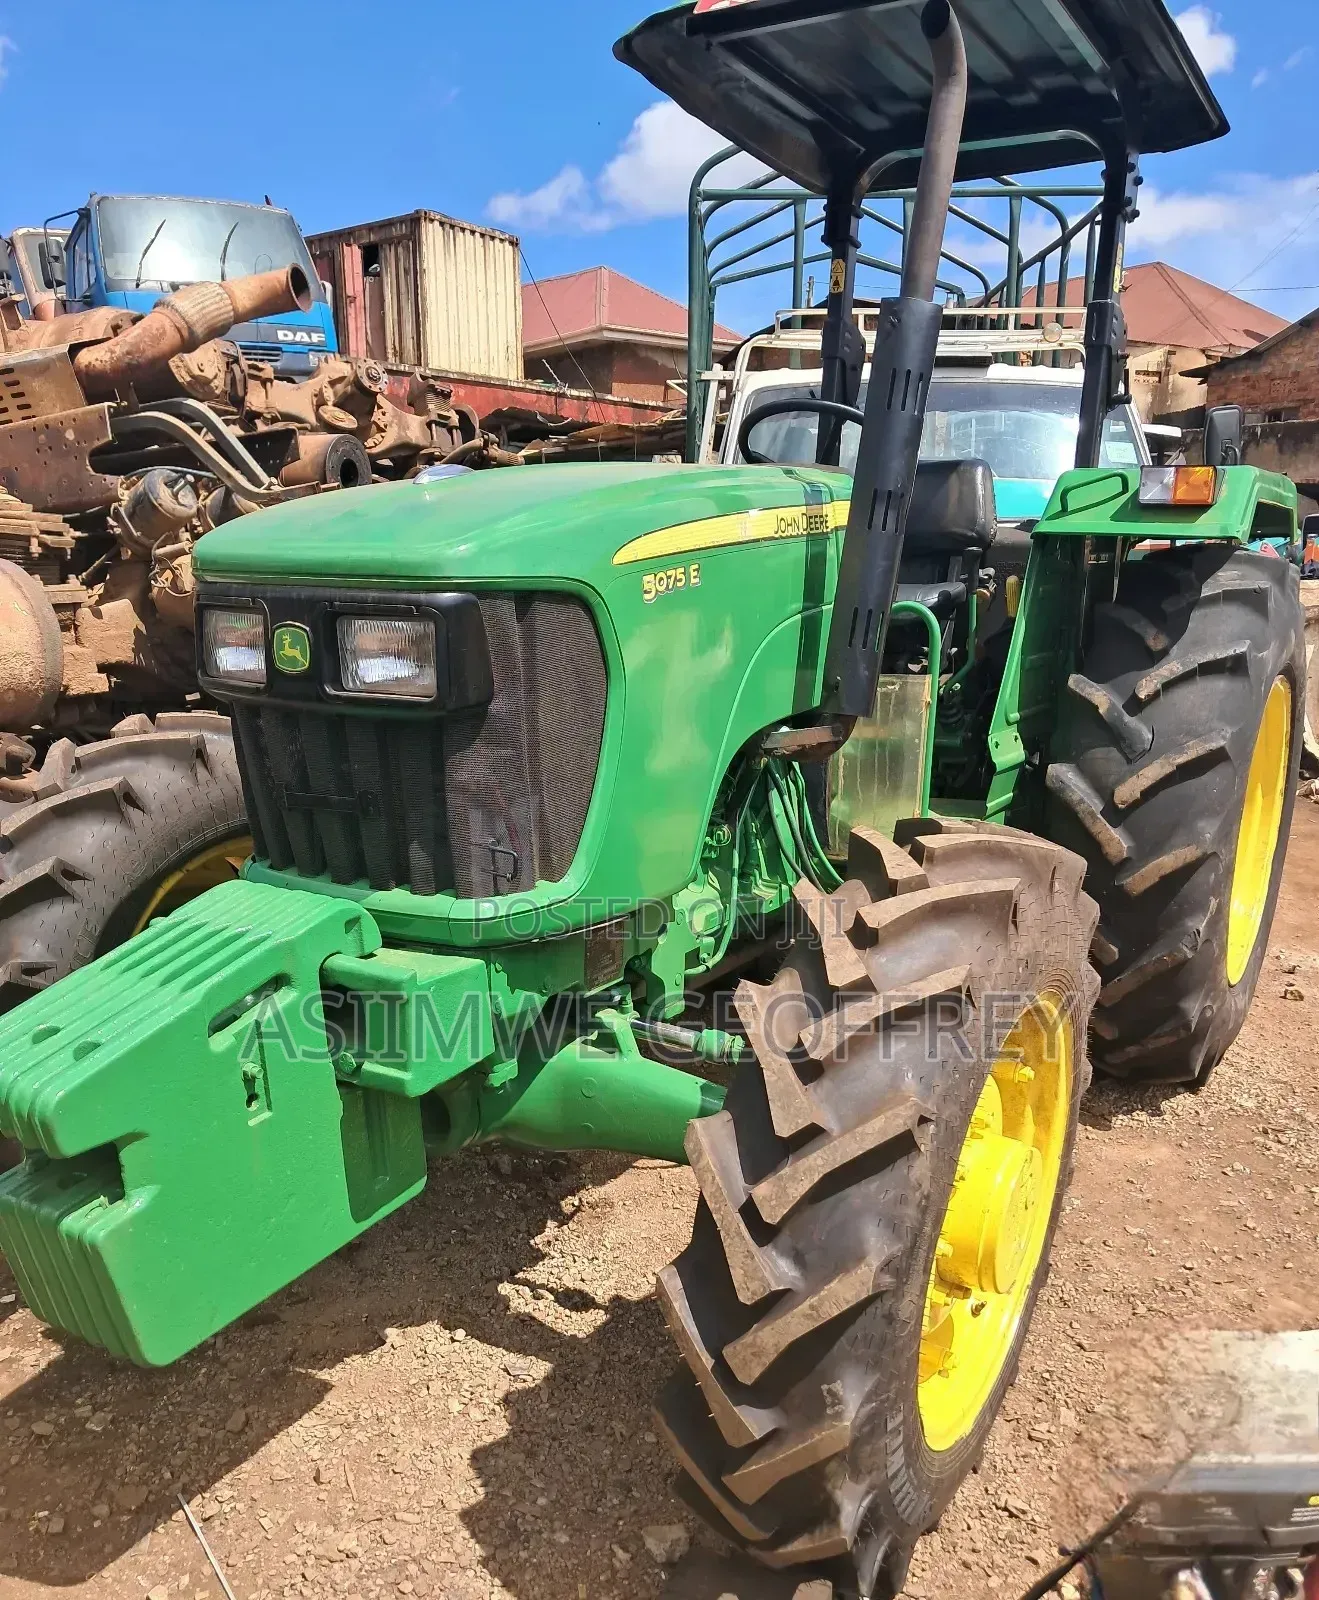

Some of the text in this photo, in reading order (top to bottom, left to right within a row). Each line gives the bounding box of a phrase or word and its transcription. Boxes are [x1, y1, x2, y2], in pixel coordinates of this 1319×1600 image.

[277, 329, 326, 343] DAF
[774, 512, 830, 535] JOHN DEERE
[642, 562, 701, 604] 5075 E
